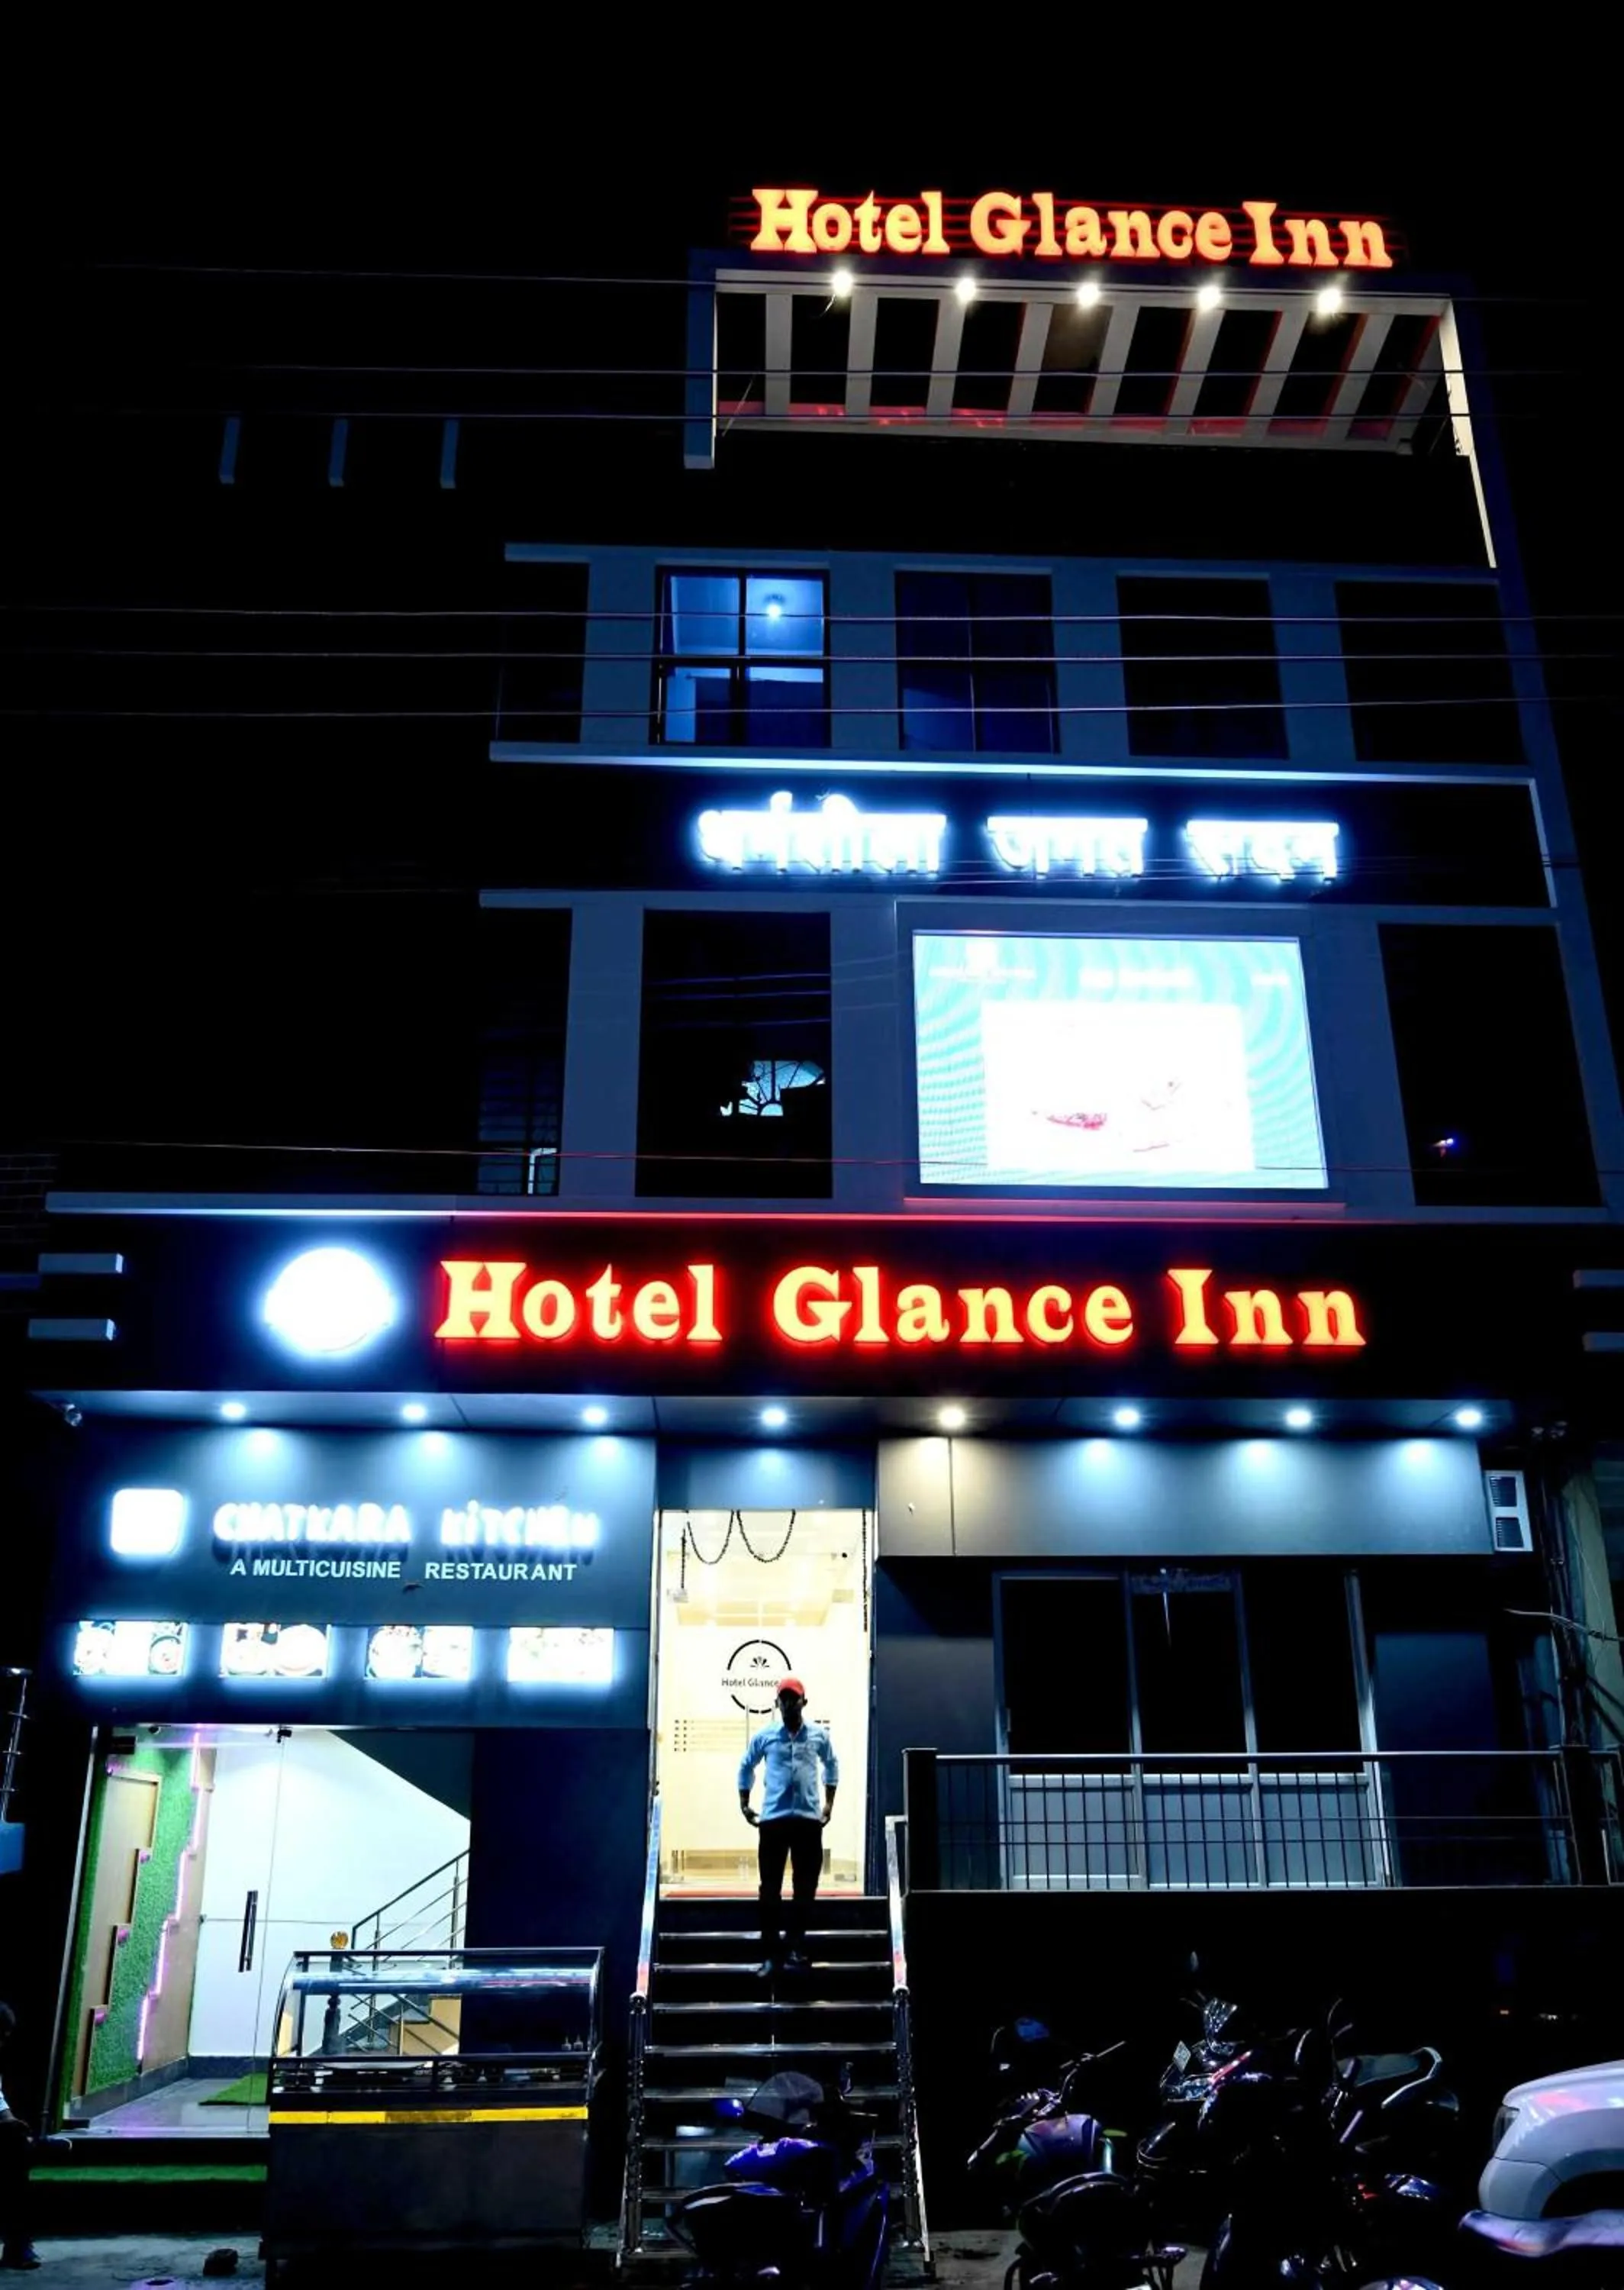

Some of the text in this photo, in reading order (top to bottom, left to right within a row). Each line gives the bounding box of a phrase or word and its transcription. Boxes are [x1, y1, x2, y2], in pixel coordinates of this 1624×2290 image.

[750, 189, 1394, 267] Hotel Glance Inn
[435, 1260, 1365, 1346] Hotel Glance Inn
[230, 1559, 578, 1580] A MULTICUISINE RESTAURANT
